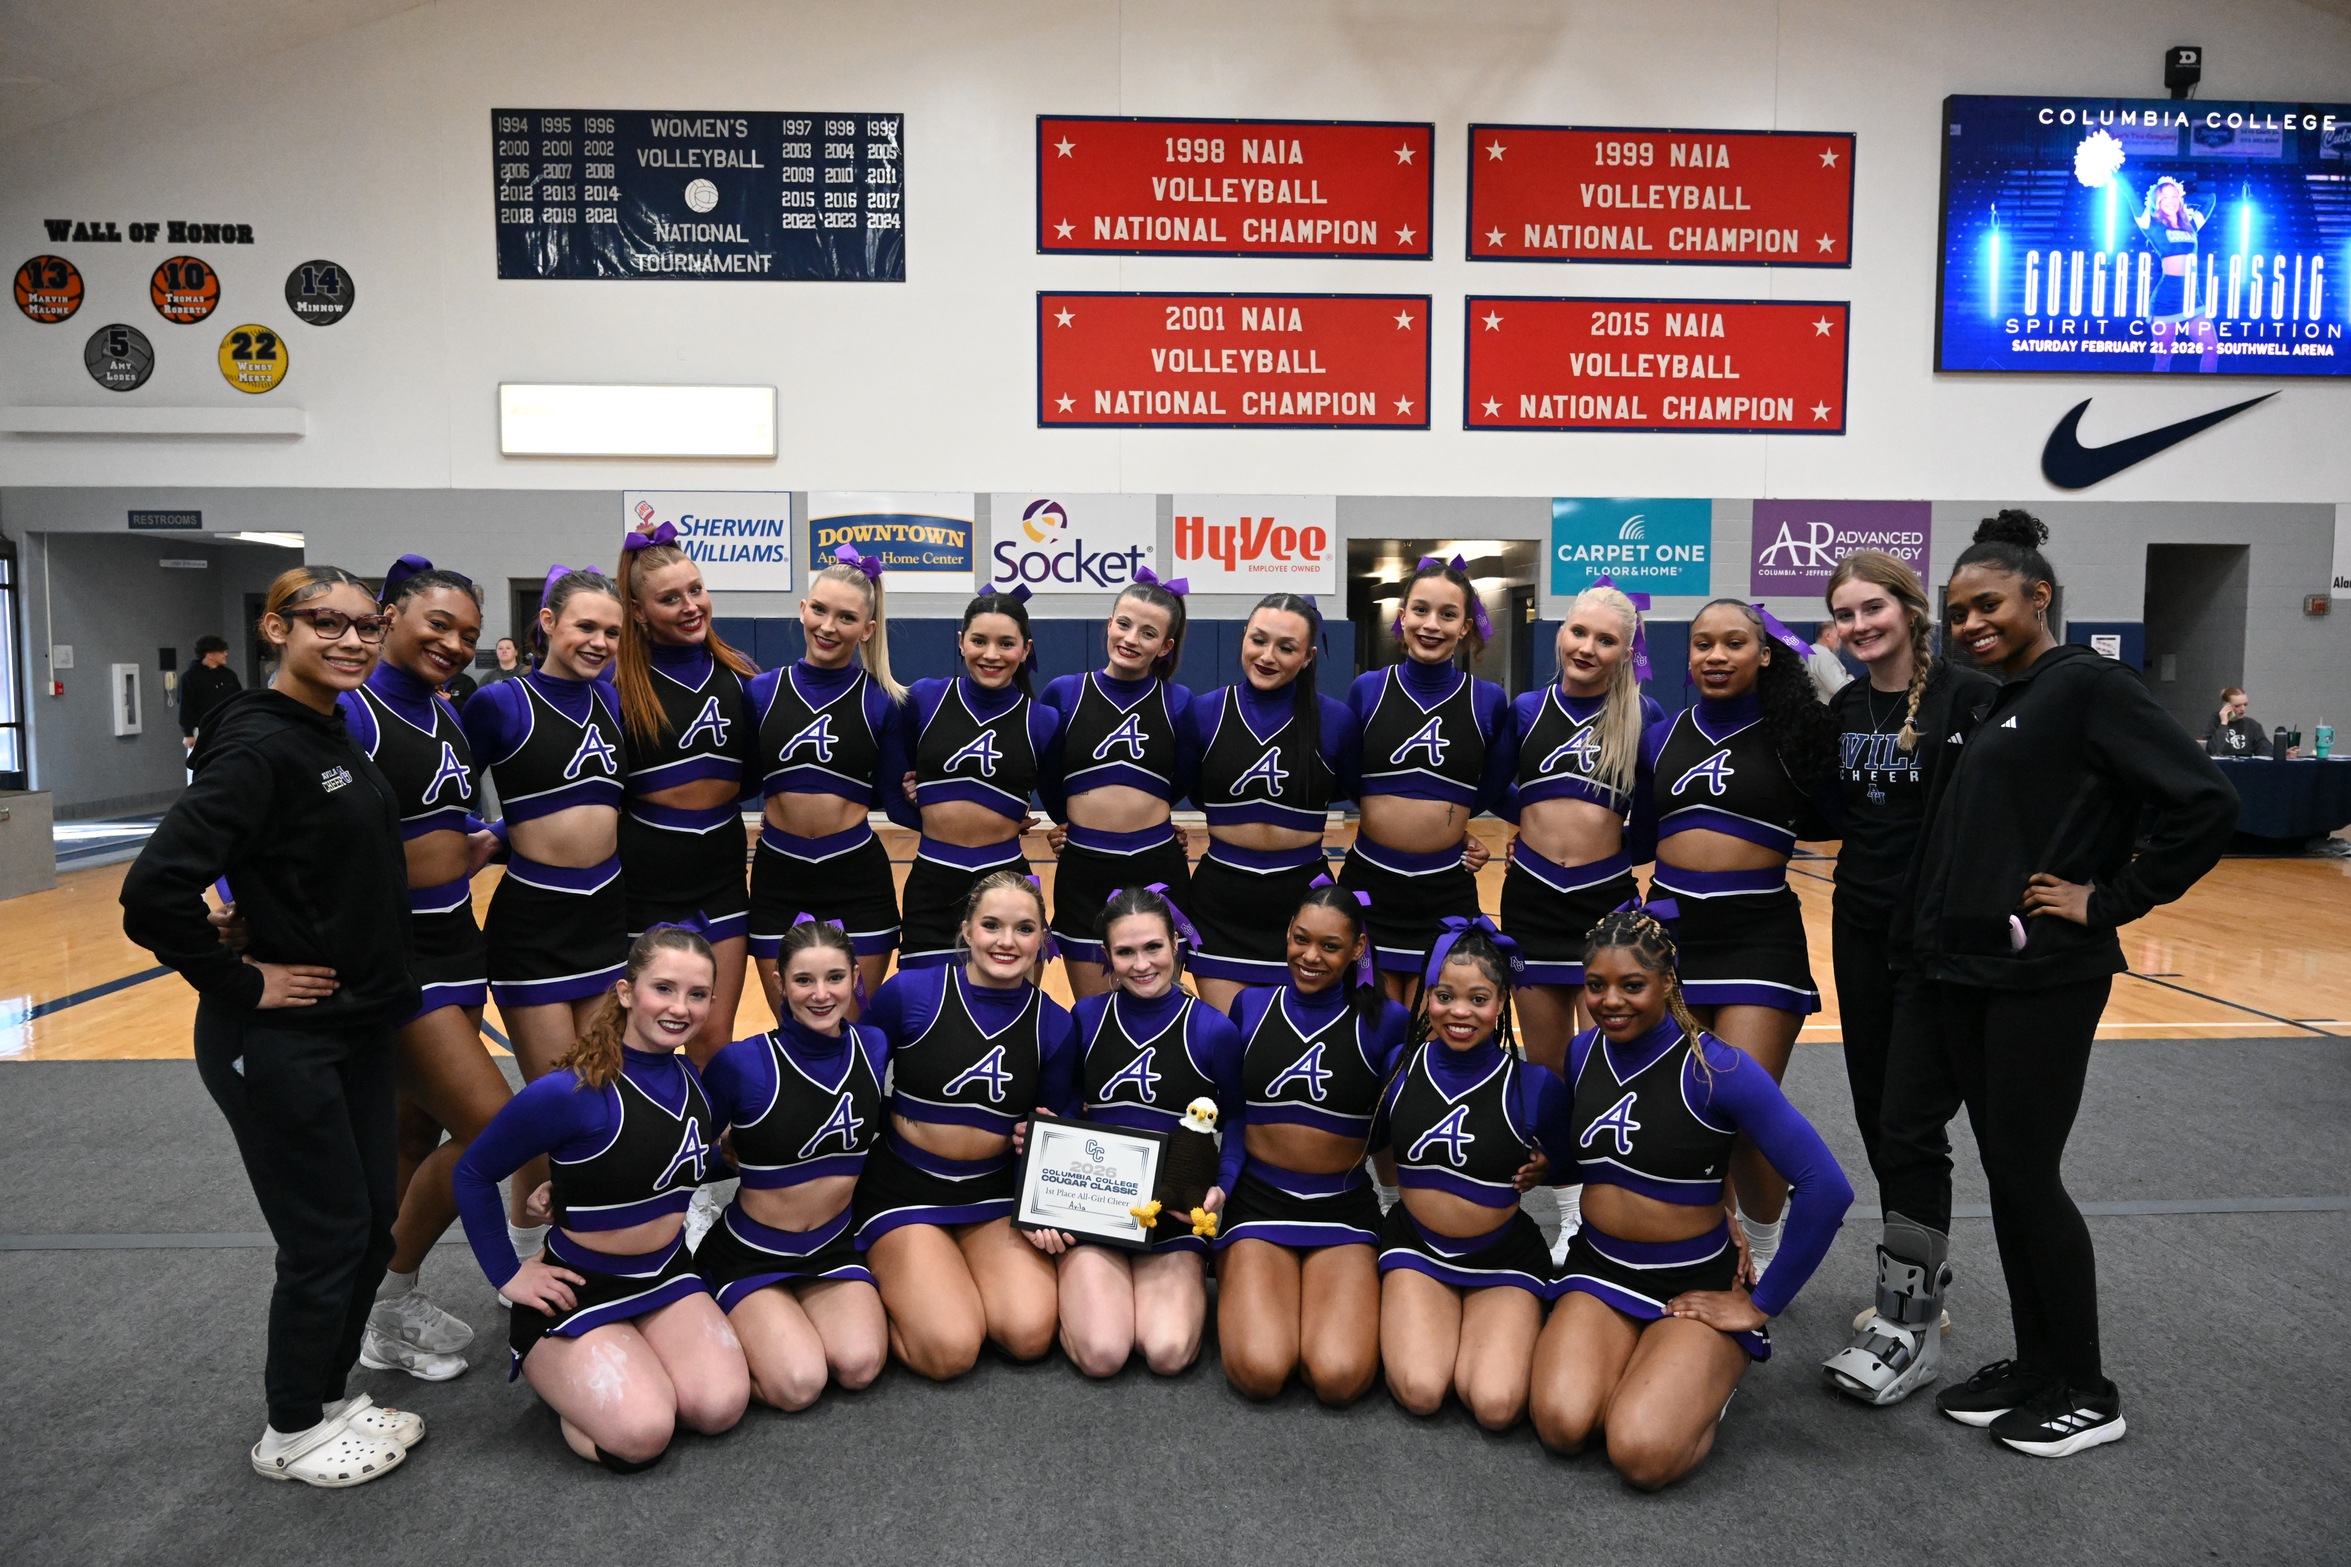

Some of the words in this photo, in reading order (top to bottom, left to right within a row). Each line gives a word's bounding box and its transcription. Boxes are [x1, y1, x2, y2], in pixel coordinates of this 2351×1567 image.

[499, 117, 528, 134] 1994
[541, 117, 572, 134] 1995
[584, 117, 615, 134] 1996
[651, 118, 748, 138] WOMEN'S
[782, 119, 812, 136] 1997
[824, 120, 855, 137] 1998
[867, 120, 898, 137] 1999
[2039, 108, 2190, 128] COLUMBIA
[2206, 112, 2337, 132] COLLEGE
[499, 140, 530, 157] 2000
[542, 140, 573, 157] 2001
[584, 141, 615, 157] 2002
[636, 149, 765, 169] VOLLEYBALL
[782, 143, 812, 159] 2003
[824, 143, 854, 159] 2004
[1166, 138, 1225, 164] 1998
[1242, 139, 1303, 165] NAIA
[1595, 141, 1654, 167] 1999
[1670, 143, 1730, 169] NAIA
[500, 163, 530, 179] 2006
[543, 163, 572, 179] 2007
[585, 163, 615, 180] 2008
[782, 167, 815, 183] 2009
[824, 167, 854, 183] 2010
[867, 168, 897, 184] 2011
[500, 185, 534, 202] 2012
[542, 185, 576, 202] 2013
[584, 185, 619, 202] 2014
[782, 191, 815, 208] 2015
[824, 192, 857, 208] 2016
[867, 192, 900, 209] 2017
[1152, 177, 1328, 204] VOLLEYBALL
[1580, 183, 1751, 210] VOLLEYBALL
[501, 208, 534, 224] 2018
[543, 208, 576, 224] 2019
[585, 208, 618, 224] 2021
[782, 213, 816, 229] 2022
[824, 213, 857, 228] 2023
[867, 213, 901, 229] 2024
[656, 223, 749, 243] NATIONAL
[1094, 216, 1227, 242] NATIONAL
[1243, 219, 1377, 245] CHAMPION
[1524, 224, 1653, 251] NATIONAL
[1668, 227, 1799, 253] CHAMPION
[29, 260, 69, 290] 13
[635, 253, 772, 274] TOURNAMENT
[166, 262, 206, 292] 10
[300, 265, 341, 296] 14
[2024, 250, 2152, 318] COUGAR
[2182, 253, 2325, 321] CLASSIC
[1166, 306, 1225, 331] 2001
[1242, 307, 1303, 332] NAIA
[1590, 312, 1650, 337] 2015
[1665, 313, 1725, 338] NAIA
[2005, 318, 2109, 335] SPIRIT
[2129, 320, 2342, 339] COMPETITION
[108, 329, 131, 358] 5
[231, 331, 277, 361] 22
[2011, 339, 2081, 353] SATURDAY
[2081, 340, 2147, 354] FEBRUARY
[2150, 341, 2168, 355] 21,
[2170, 341, 2204, 355] 2026
[2216, 342, 2290, 356] SOUTHWELL
[2292, 343, 2335, 357] ARENA
[1151, 348, 1327, 374] VOLLEYBALL
[1569, 353, 1740, 379] VOLLEYBALL
[1094, 390, 1227, 415] NATIONAL
[1242, 391, 1376, 416] CHAMPION
[1520, 395, 1647, 420] NATIONAL
[1662, 396, 1794, 422] CHAMPION
[133, 515, 197, 525] RESTROOMS
[677, 514, 784, 537] SHERWIN
[818, 524, 966, 549] DOWNTOWN
[1835, 532, 1924, 545] ADVANCED
[882, 552, 919, 564] Home
[922, 552, 964, 564] Center
[994, 539, 1145, 588] Socket
[1557, 544, 1650, 562] CARPET
[1655, 544, 1705, 562] ONE
[1248, 565, 1288, 573] EMPLOYEE
[1291, 565, 1321, 573] OWNED
[1585, 566, 1678, 577] FLOOR&HOME
[678, 695, 731, 750] A
[778, 714, 839, 763] A
[1092, 712, 1150, 760] A
[1389, 715, 1451, 767] A
[563, 723, 617, 780] A
[943, 728, 1003, 778] A
[1539, 726, 1601, 773] A
[422, 741, 471, 805] A
[1229, 746, 1289, 797] A
[1670, 748, 1734, 796] A
[943, 1045, 1013, 1102] A
[1099, 1046, 1162, 1103] A
[1265, 1042, 1333, 1101] A
[797, 1091, 864, 1159] A
[1408, 1104, 1475, 1167] A
[1579, 1091, 1641, 1155] A
[652, 1117, 709, 1191] A
[1042, 1168, 1091, 1181] COLUMBIA
[1095, 1177, 1139, 1188] COLLEGE
[1069, 1160, 1118, 1179] 2026
[1041, 1174, 1088, 1188] COUGAR
[1090, 1182, 1138, 1196] CLASSIC
[1045, 1187, 1055, 1195] 1st
[1056, 1188, 1076, 1199] Place
[1078, 1192, 1106, 1203] All-Girl
[1107, 1196, 1130, 1207] Cheer
